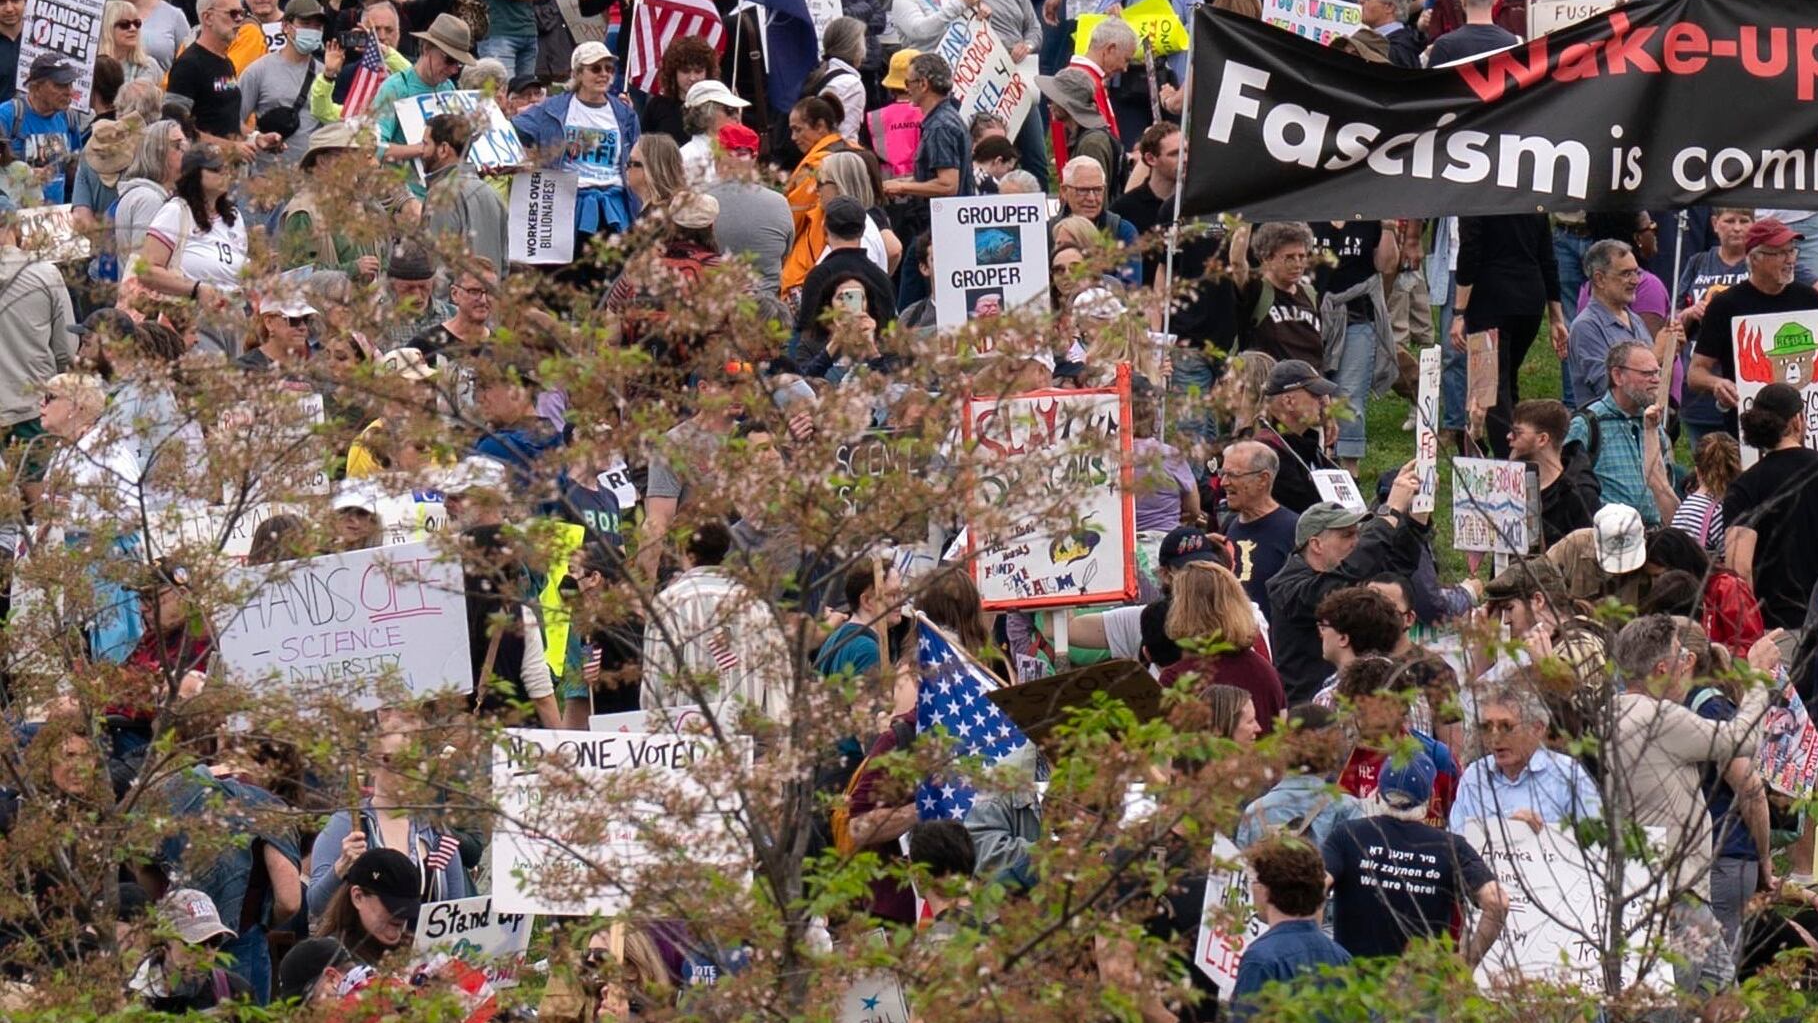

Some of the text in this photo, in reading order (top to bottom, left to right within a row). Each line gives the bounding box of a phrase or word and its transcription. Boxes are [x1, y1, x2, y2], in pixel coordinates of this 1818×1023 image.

[36, 1, 92, 31] HANDS
[33, 18, 89, 58] OFF!
[1207, 59, 1591, 200] Fascism
[1610, 124, 1642, 191] is
[526, 170, 544, 258] WORKERS OVER
[540, 179, 557, 249] BILLIONAIRES!
[957, 206, 1039, 225] GROUPER
[216, 243, 234, 265] 19
[951, 267, 1021, 288] GROPER
[1776, 334, 1810, 347] RESIST
[239, 558, 443, 633] HANDS OFF
[278, 624, 406, 662] SCIENCE
[290, 653, 402, 685] DIVERSITY
[556, 738, 617, 770] ONE
[1481, 840, 1555, 863] America is
[1360, 859, 1441, 879] Mir zaynen do
[1360, 875, 1436, 896] We are here!
[426, 899, 492, 938] Stand
